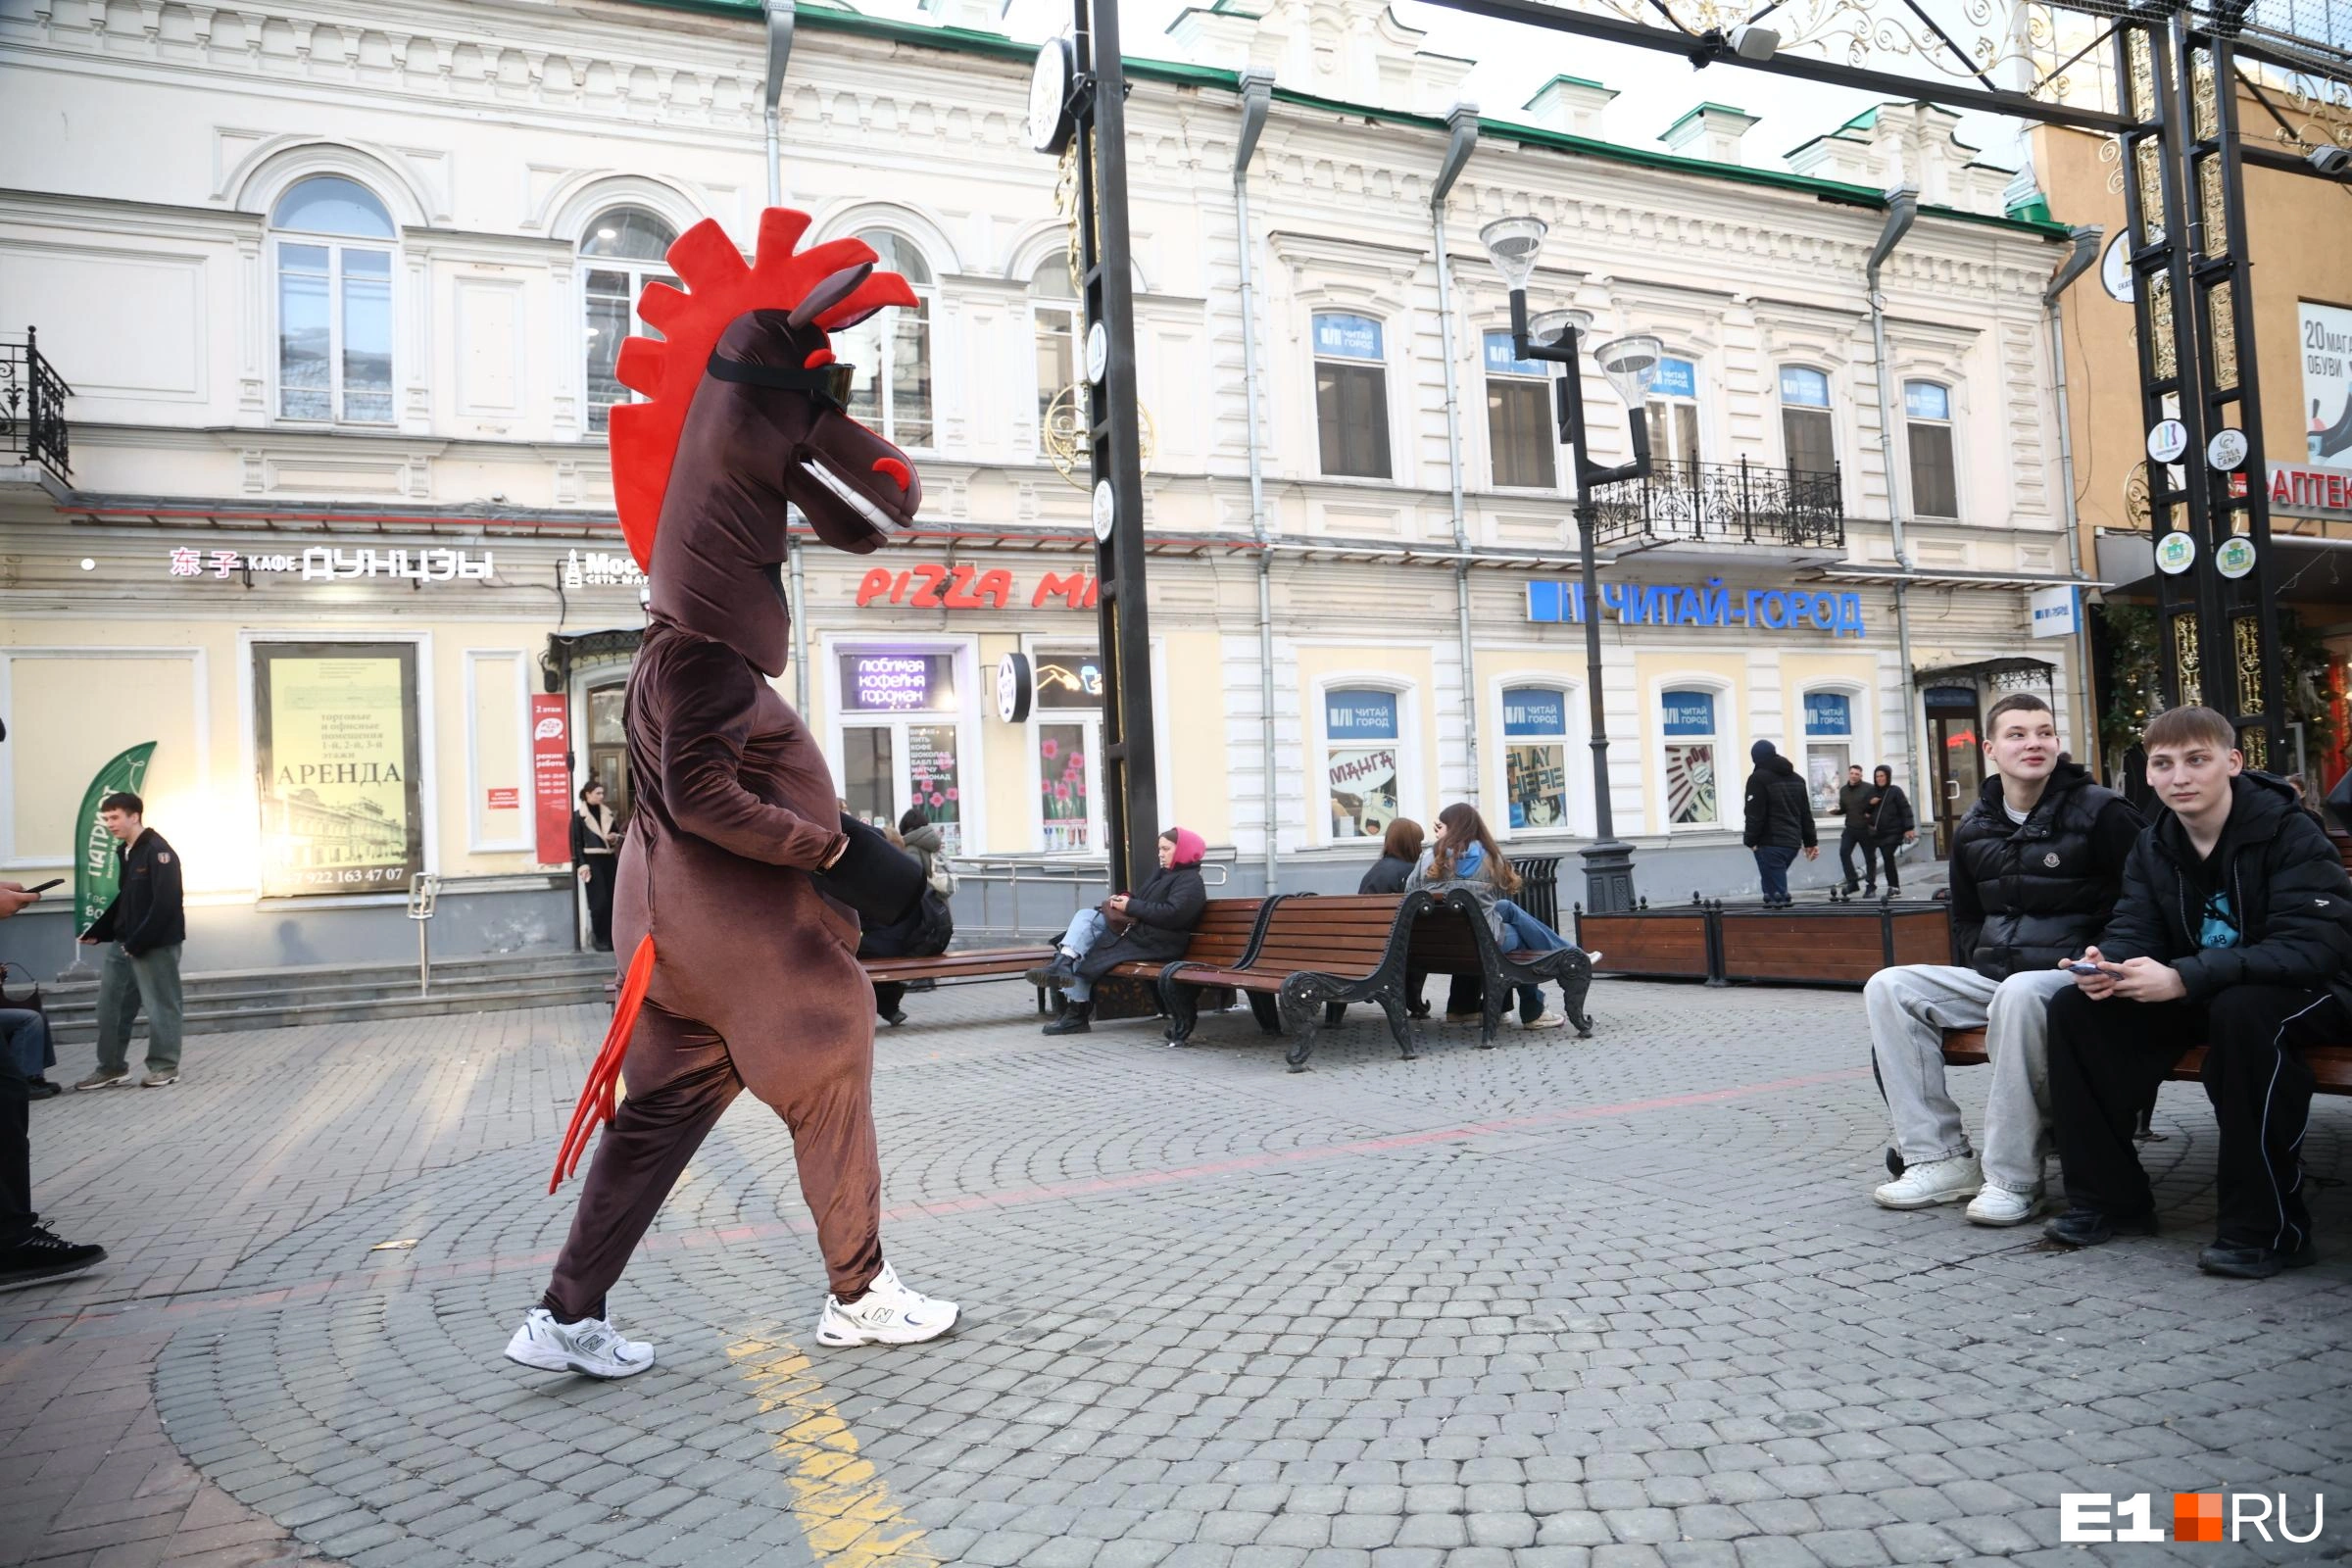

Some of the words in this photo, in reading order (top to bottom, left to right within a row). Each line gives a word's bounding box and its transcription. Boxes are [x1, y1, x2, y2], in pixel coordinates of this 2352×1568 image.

[2305, 319, 2326, 350] 20
[1345, 339, 1374, 351] ГОРОД
[2307, 354, 2343, 377] ОБУВИ
[248, 555, 296, 571] КАФЕ
[302, 546, 493, 583] ДУНЦЗЫ
[856, 564, 1012, 608] PIZZA
[1600, 576, 1866, 638] ЧИТАЙ-ГОРОД
[858, 673, 925, 690] кофейня
[861, 690, 923, 705] горожан
[1354, 706, 1389, 717] ЧИТАЙ
[1527, 704, 1557, 714] ЧИТАЙ
[1680, 705, 1708, 715] ЧИТАЙ
[1819, 707, 1844, 716] ЧИТАЙ
[321, 713, 371, 722] торговые
[1355, 717, 1390, 728] ГОРОД
[1528, 714, 1558, 725] ГОРОД
[1681, 715, 1709, 725] ГОРОД
[1820, 716, 1845, 726] ГОРОД
[329, 721, 380, 732] офисные
[321, 732, 383, 741] помещения
[536, 760, 565, 768] работы
[1506, 746, 1551, 772] PLAY
[1329, 751, 1396, 785] МАНГА
[277, 762, 403, 787] АРЕНДА
[1507, 767, 1565, 799] HERE
[305, 869, 333, 883] 922
[337, 868, 363, 883] 163
[366, 867, 383, 881] 47
[385, 866, 404, 880] 07
